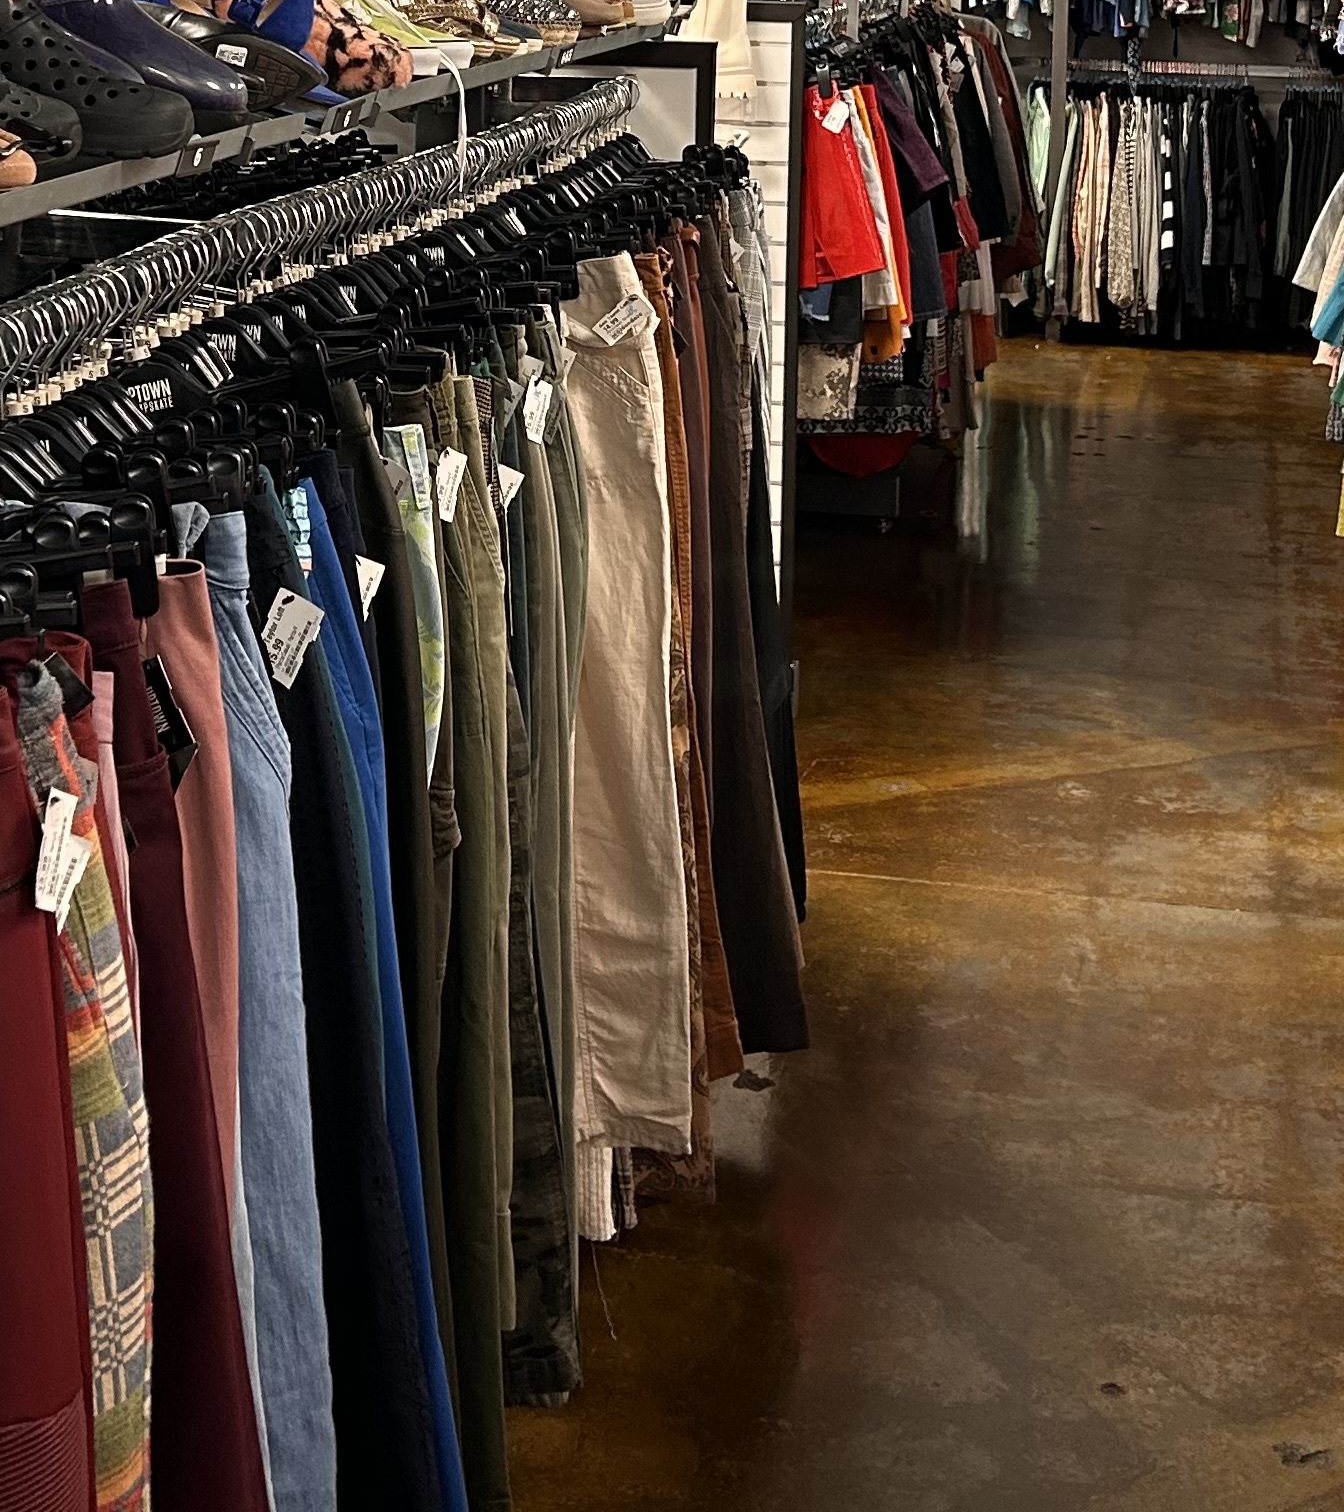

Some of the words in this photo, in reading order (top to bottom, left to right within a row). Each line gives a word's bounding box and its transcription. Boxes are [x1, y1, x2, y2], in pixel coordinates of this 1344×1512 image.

[343, 110, 352, 128] 6
[192, 147, 204, 167] 6
[127, 378, 172, 402] PTOWN
